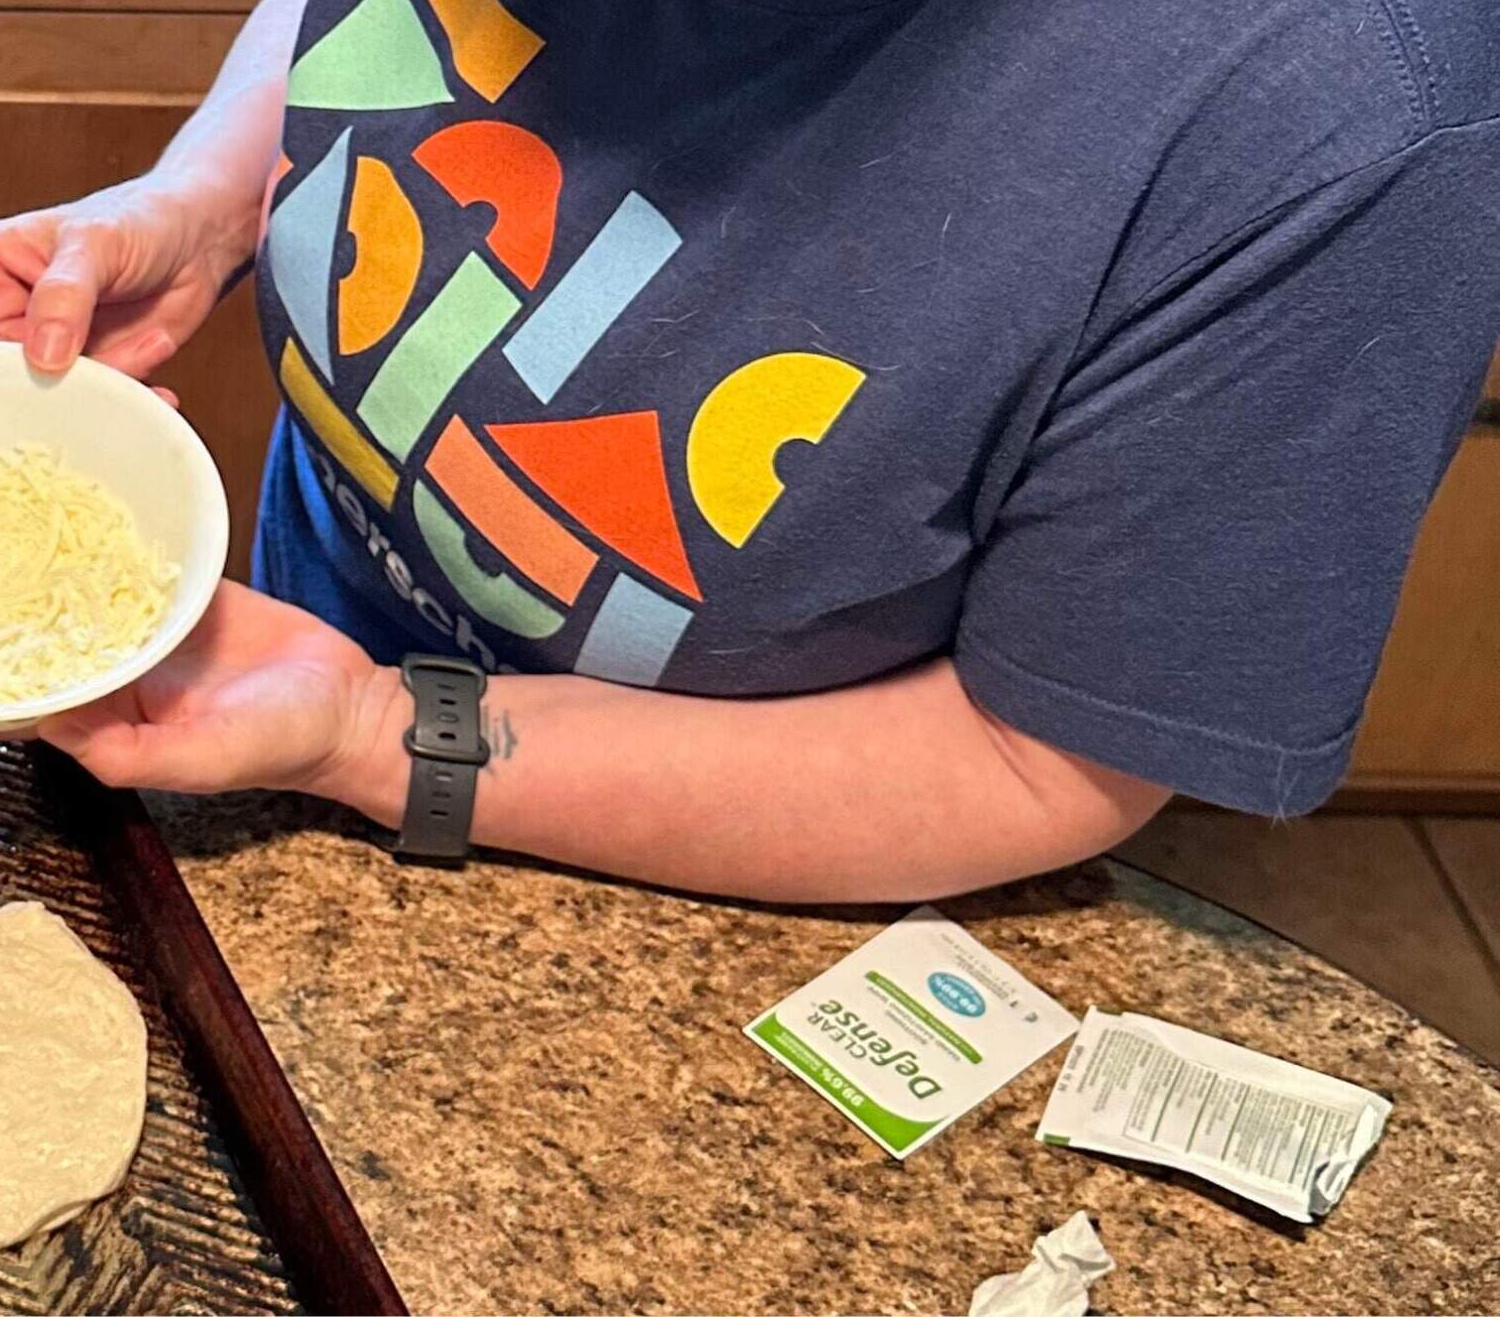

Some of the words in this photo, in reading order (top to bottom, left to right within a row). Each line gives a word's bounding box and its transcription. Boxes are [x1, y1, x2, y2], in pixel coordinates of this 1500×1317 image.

[807, 1009, 865, 1058] CLEAR
[819, 997, 942, 1098] Defense
[819, 1067, 865, 1106] 99.6%
